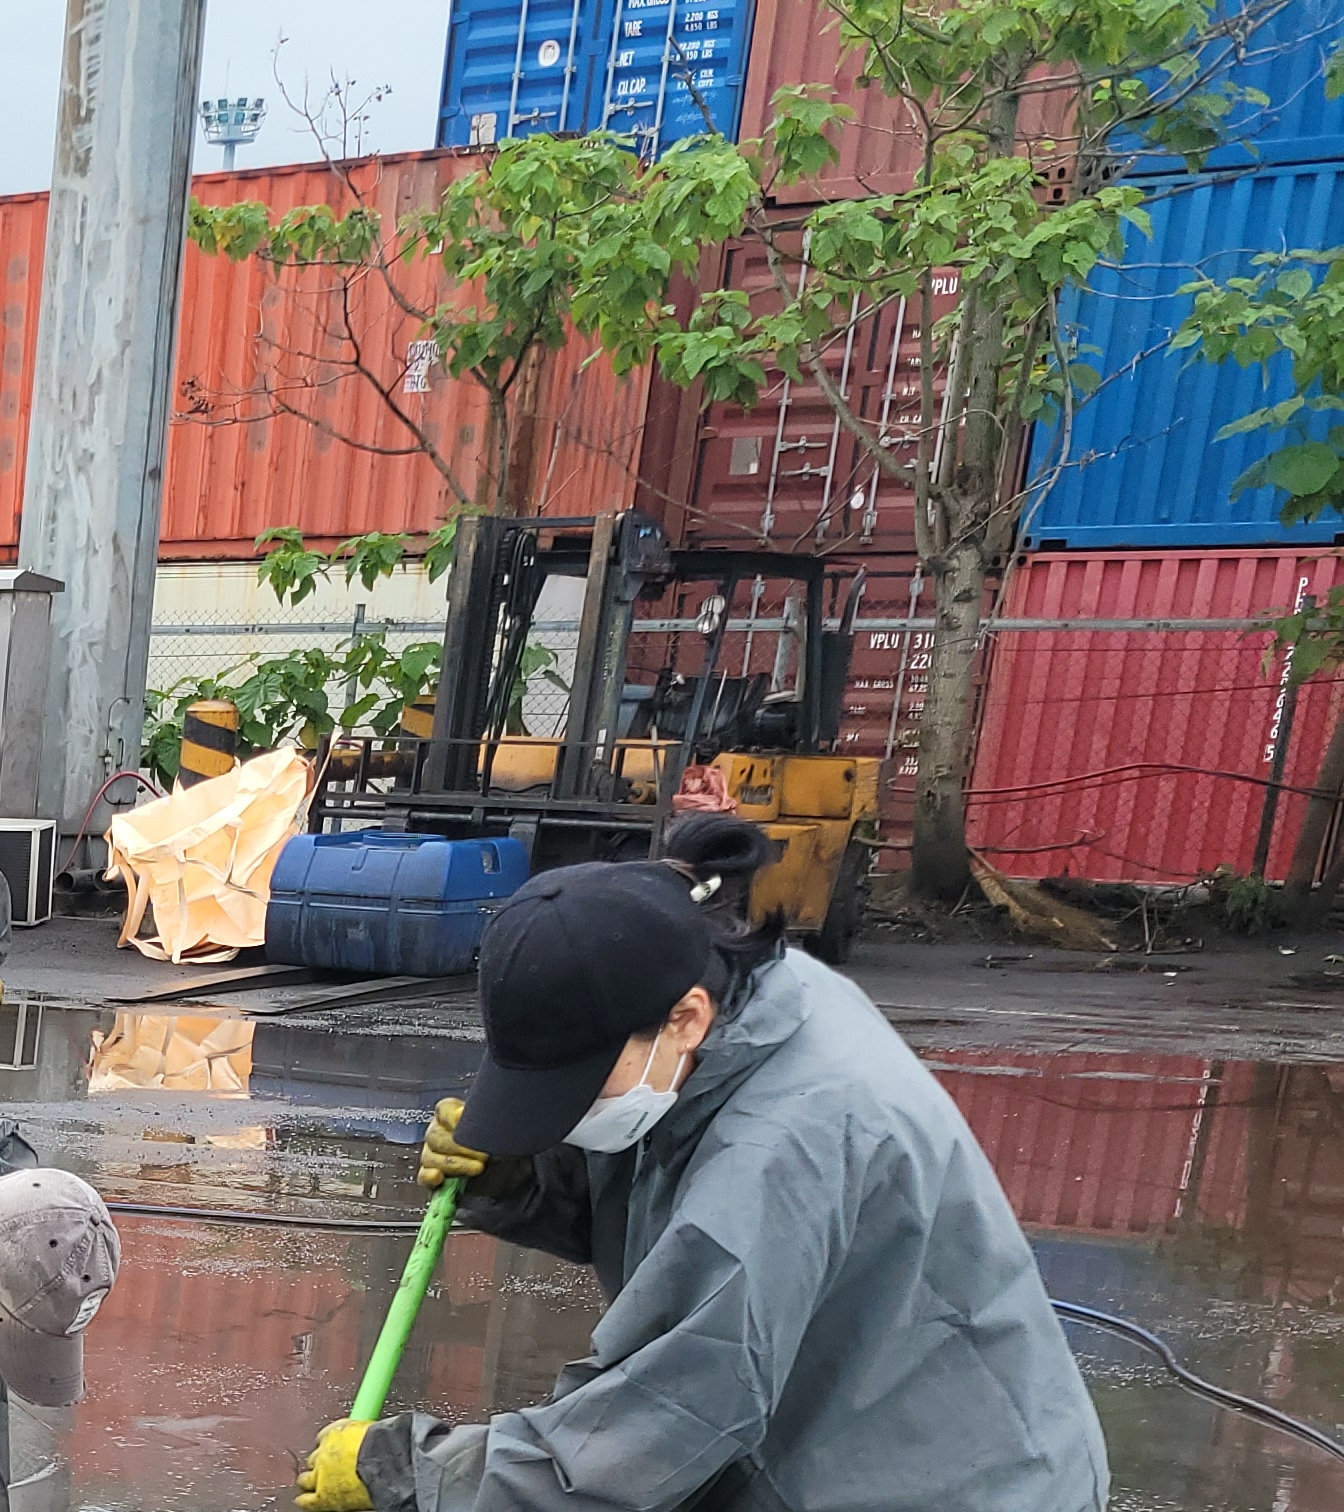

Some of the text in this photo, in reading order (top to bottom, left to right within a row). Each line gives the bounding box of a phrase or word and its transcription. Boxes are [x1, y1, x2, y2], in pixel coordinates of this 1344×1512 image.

[624, 20, 643, 37] TARE
[620, 51, 635, 66] NET
[870, 633, 900, 649] VPLU
